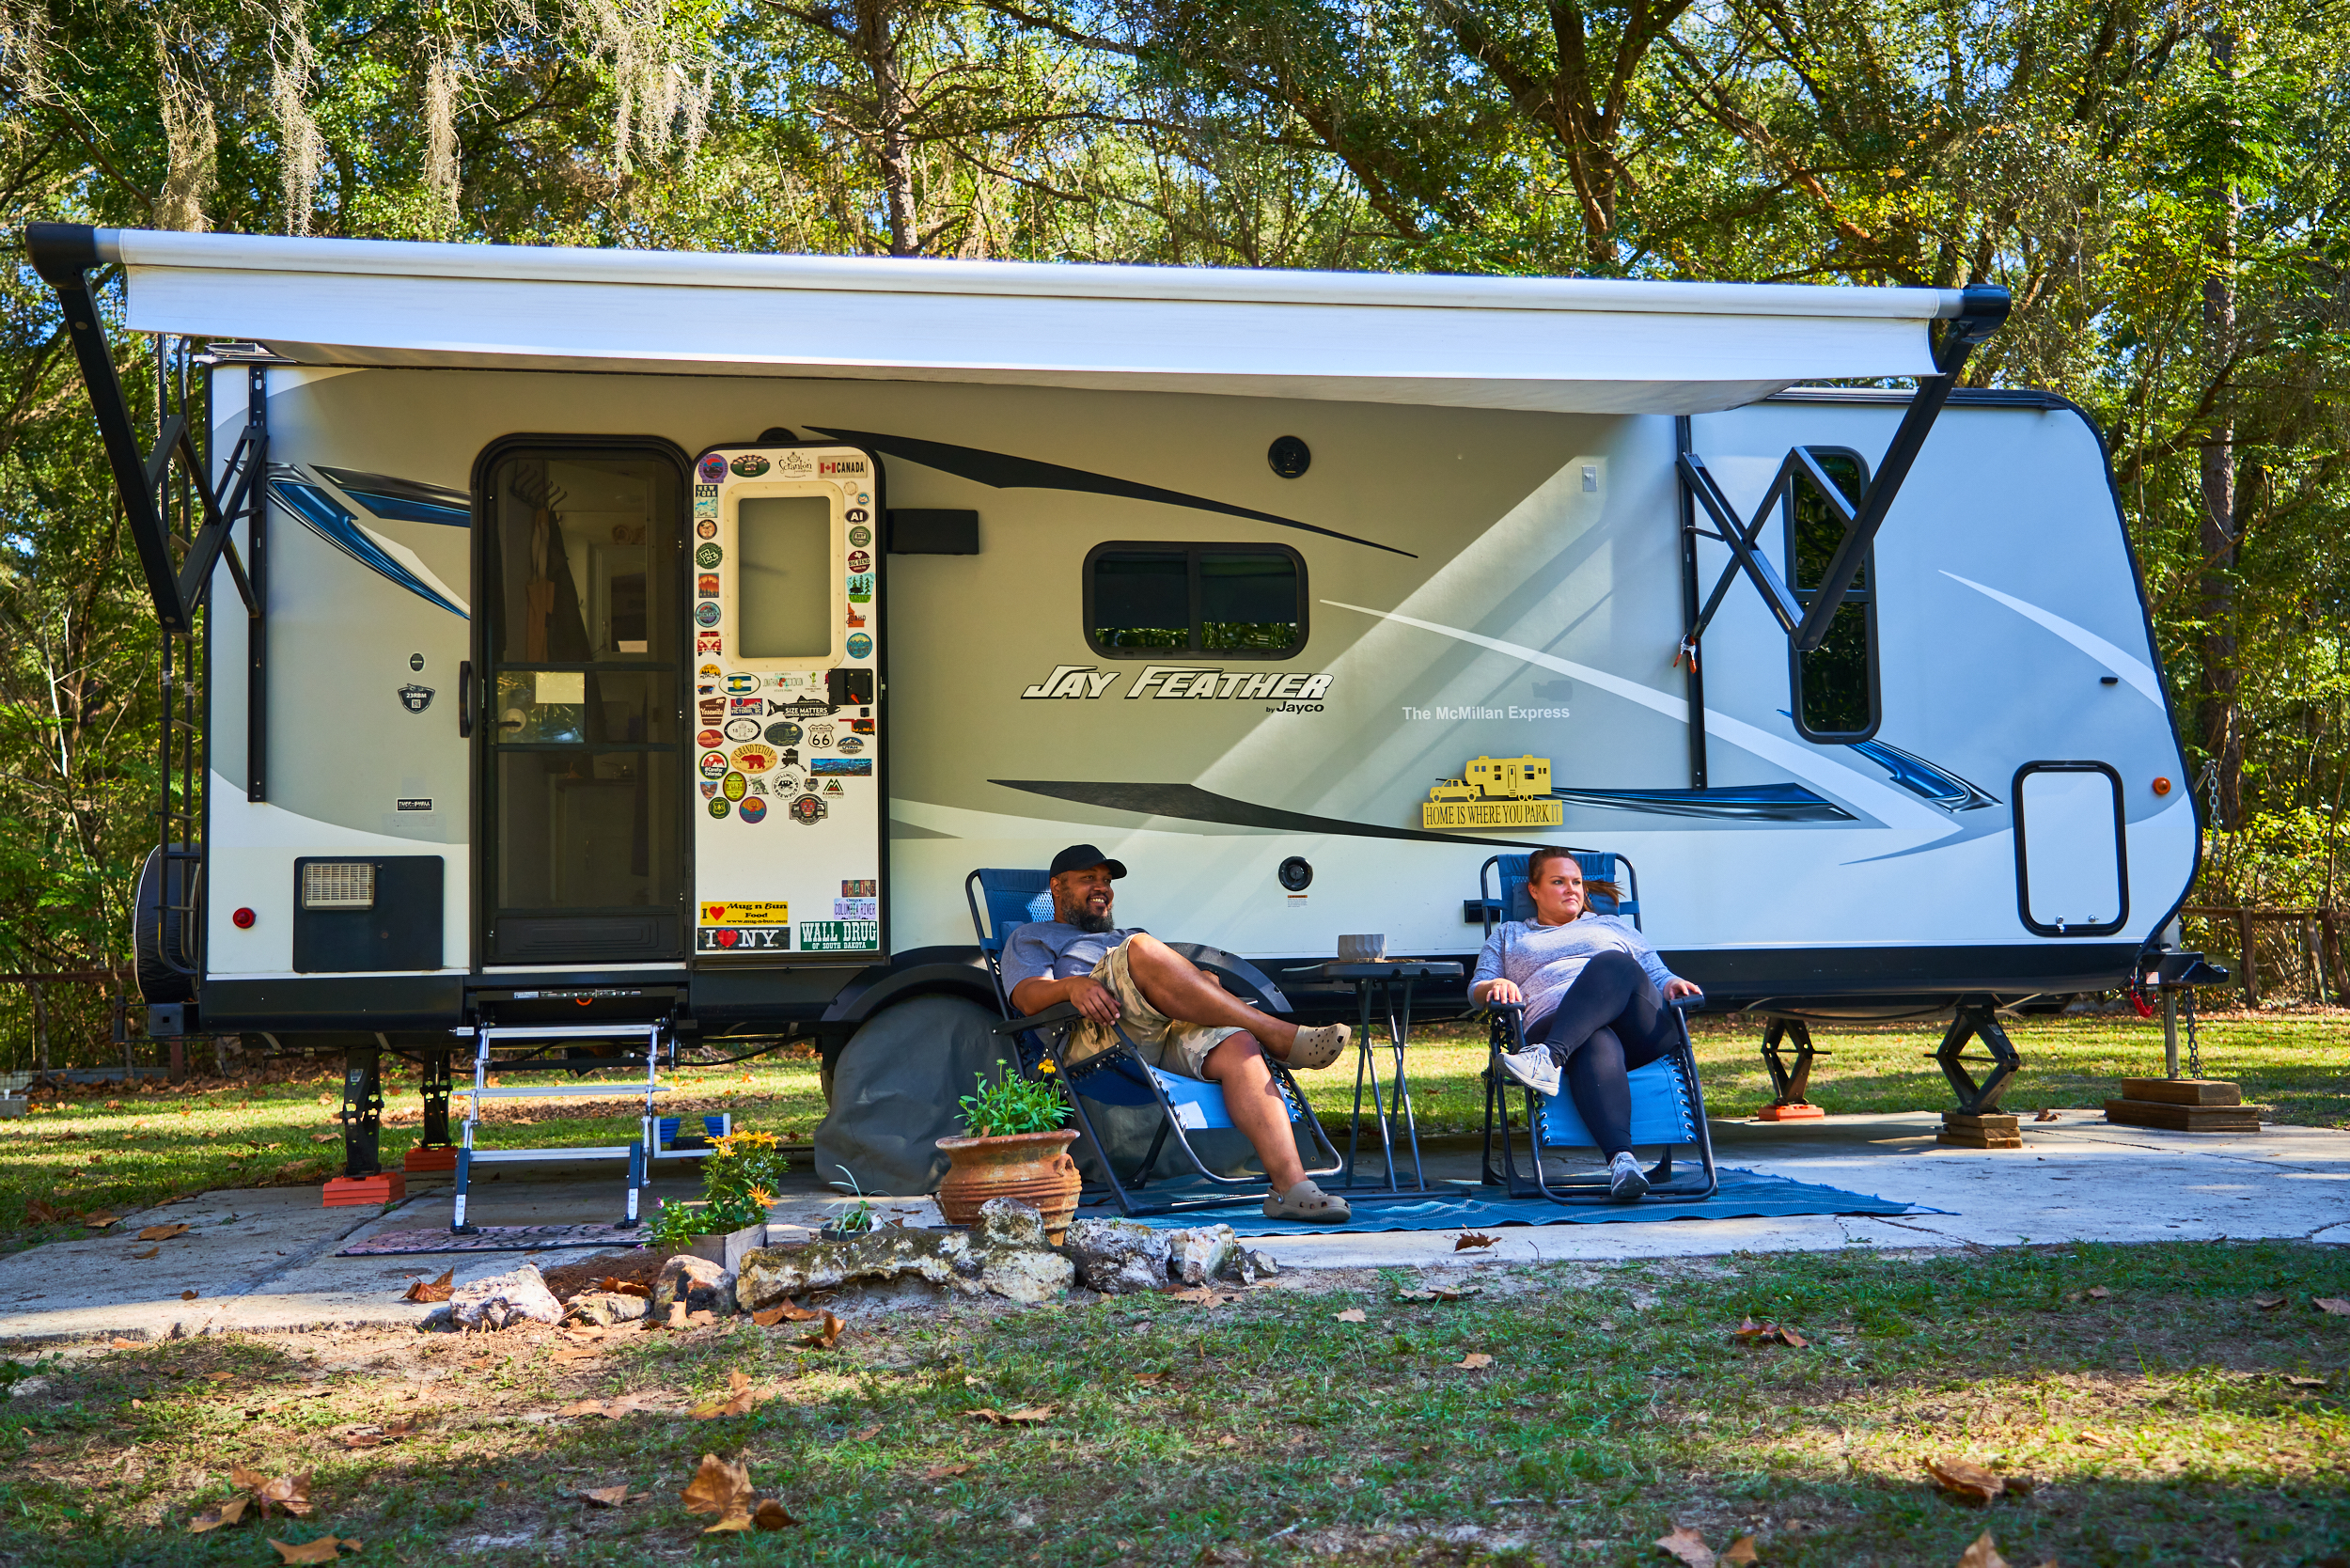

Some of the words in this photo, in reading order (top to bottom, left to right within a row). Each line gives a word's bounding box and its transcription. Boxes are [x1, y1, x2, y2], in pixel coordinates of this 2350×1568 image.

[778, 459, 813, 474] Scranton
[837, 462, 865, 474] CANADA
[850, 511, 864, 521] AI
[846, 612, 867, 625] IDAHO
[1020, 665, 1121, 699] JAY
[1124, 665, 1335, 700] FEATHER
[1276, 701, 1324, 714] Jayco
[1402, 707, 1432, 720] The
[1435, 706, 1504, 720] McMillan
[1508, 705, 1571, 722] Express
[812, 734, 830, 745] 66
[733, 745, 755, 758] GRAND
[754, 744, 775, 758] TETON
[775, 789, 798, 798] BREWPUB
[1426, 807, 1455, 825] HOME
[1457, 806, 1466, 824] IS
[1467, 805, 1502, 823] WHERE
[1502, 805, 1523, 823] YOU
[1525, 805, 1550, 823] PARK
[1551, 804, 1560, 823] IT
[848, 884, 876, 895] MAINE
[701, 908, 708, 919] I
[835, 903, 859, 916] COLUMBIA
[860, 903, 876, 916] RIVER
[705, 929, 716, 948] I
[738, 929, 779, 948] NY
[801, 922, 838, 943] WALL
[842, 921, 877, 942] DRUG
